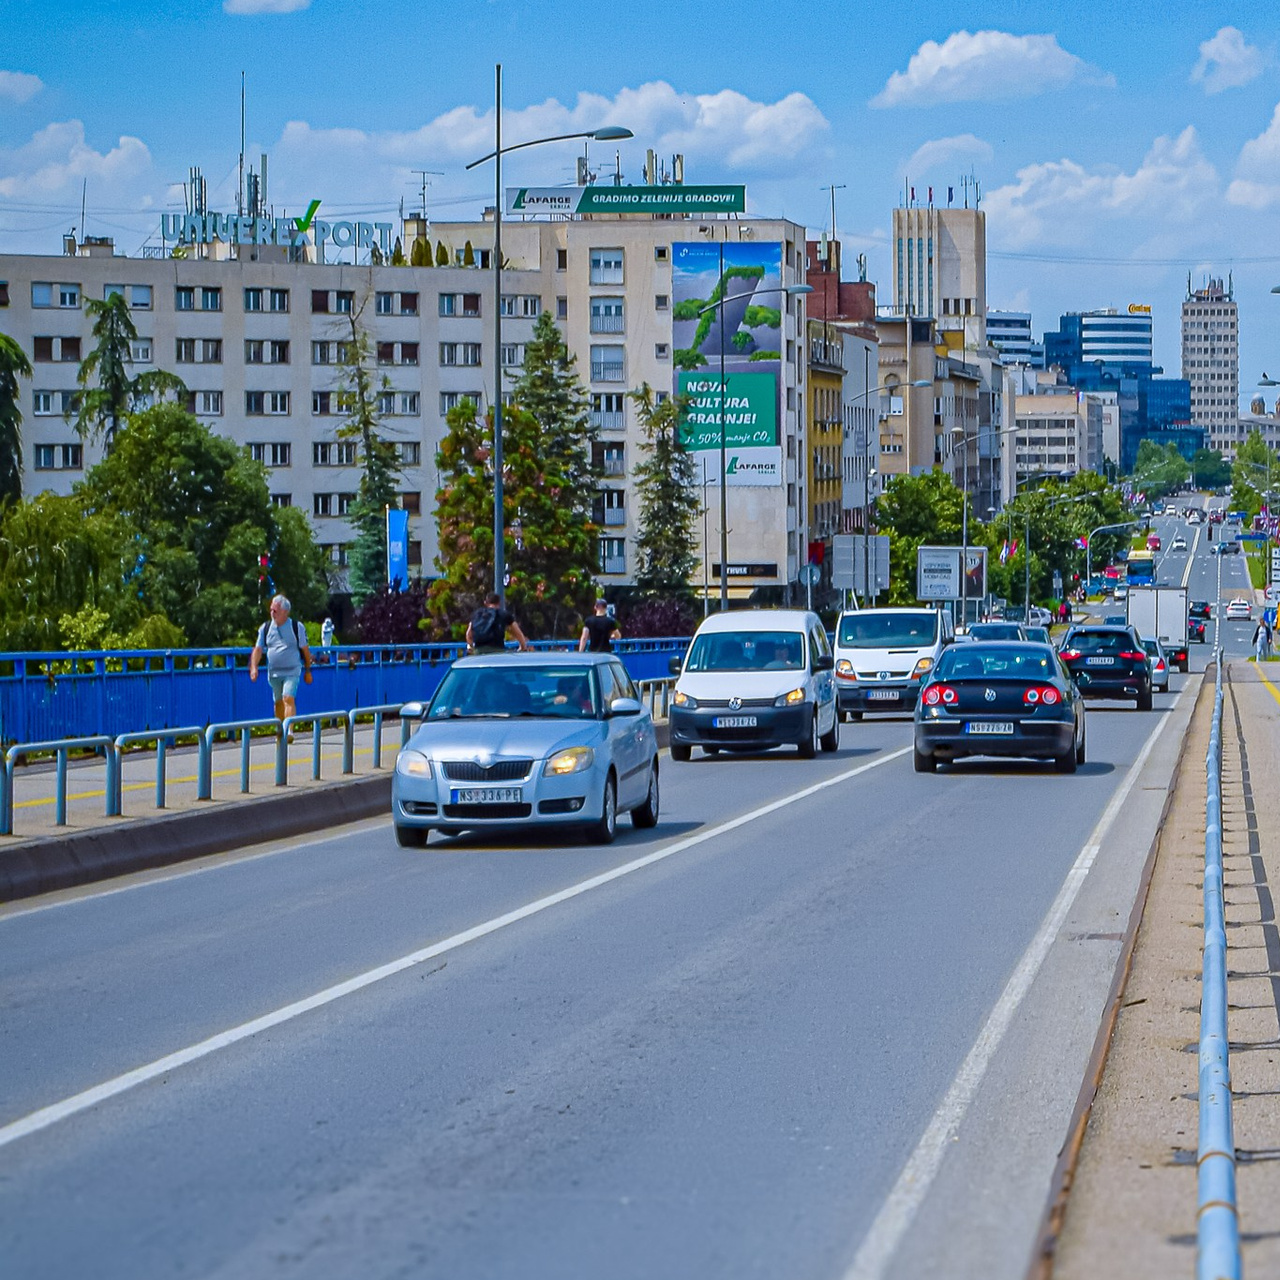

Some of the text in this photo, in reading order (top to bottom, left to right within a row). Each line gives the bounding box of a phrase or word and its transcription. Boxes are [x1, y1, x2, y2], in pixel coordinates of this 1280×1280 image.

[592, 194, 639, 203] GRADIMO
[640, 194, 683, 203] ZELENIJE
[161, 200, 393, 250] UNIVEREXPORT
